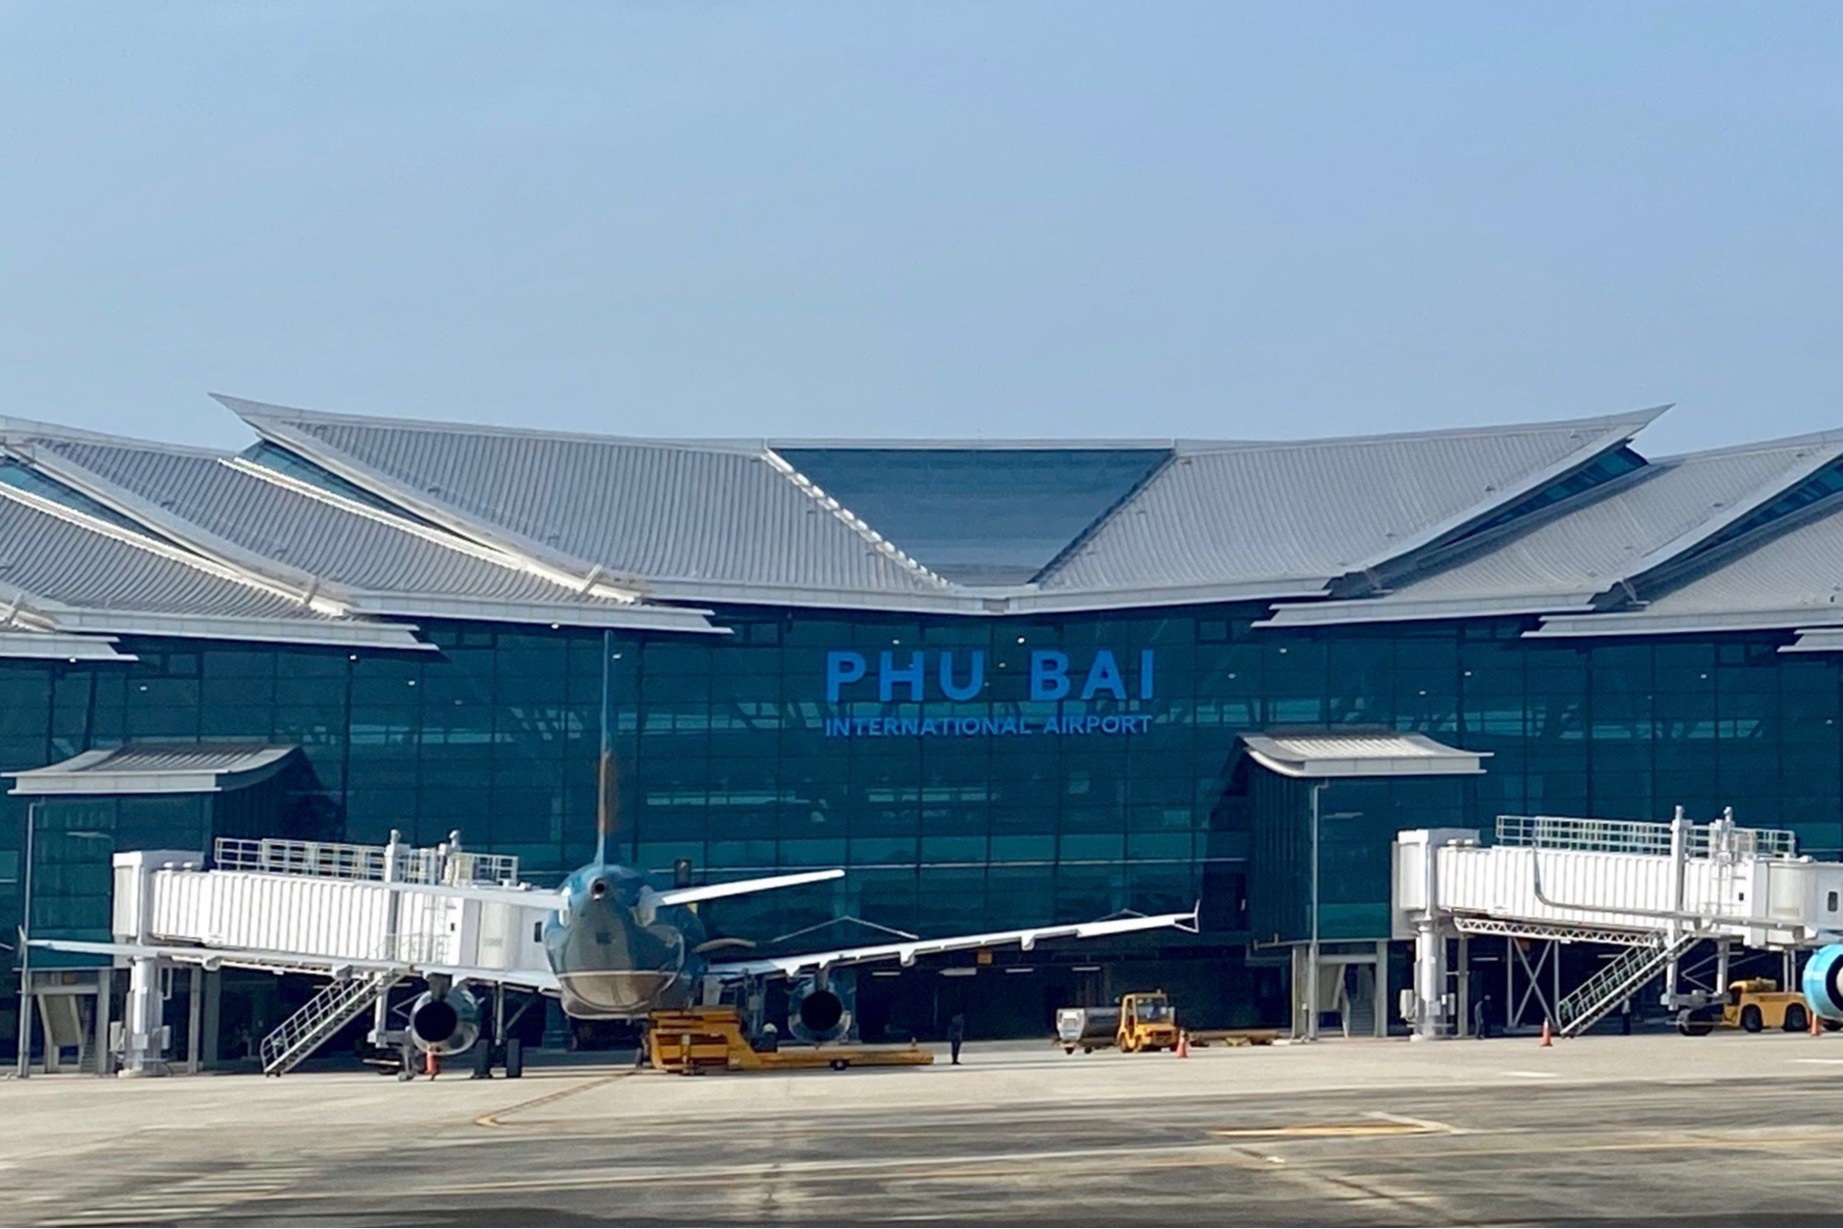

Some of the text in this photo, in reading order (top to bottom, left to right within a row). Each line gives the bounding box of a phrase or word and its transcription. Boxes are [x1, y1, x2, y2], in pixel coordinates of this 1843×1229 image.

[826, 649, 1155, 702] PHU BAI
[825, 714, 1153, 737] INTERNATIONAL AIRPORT
